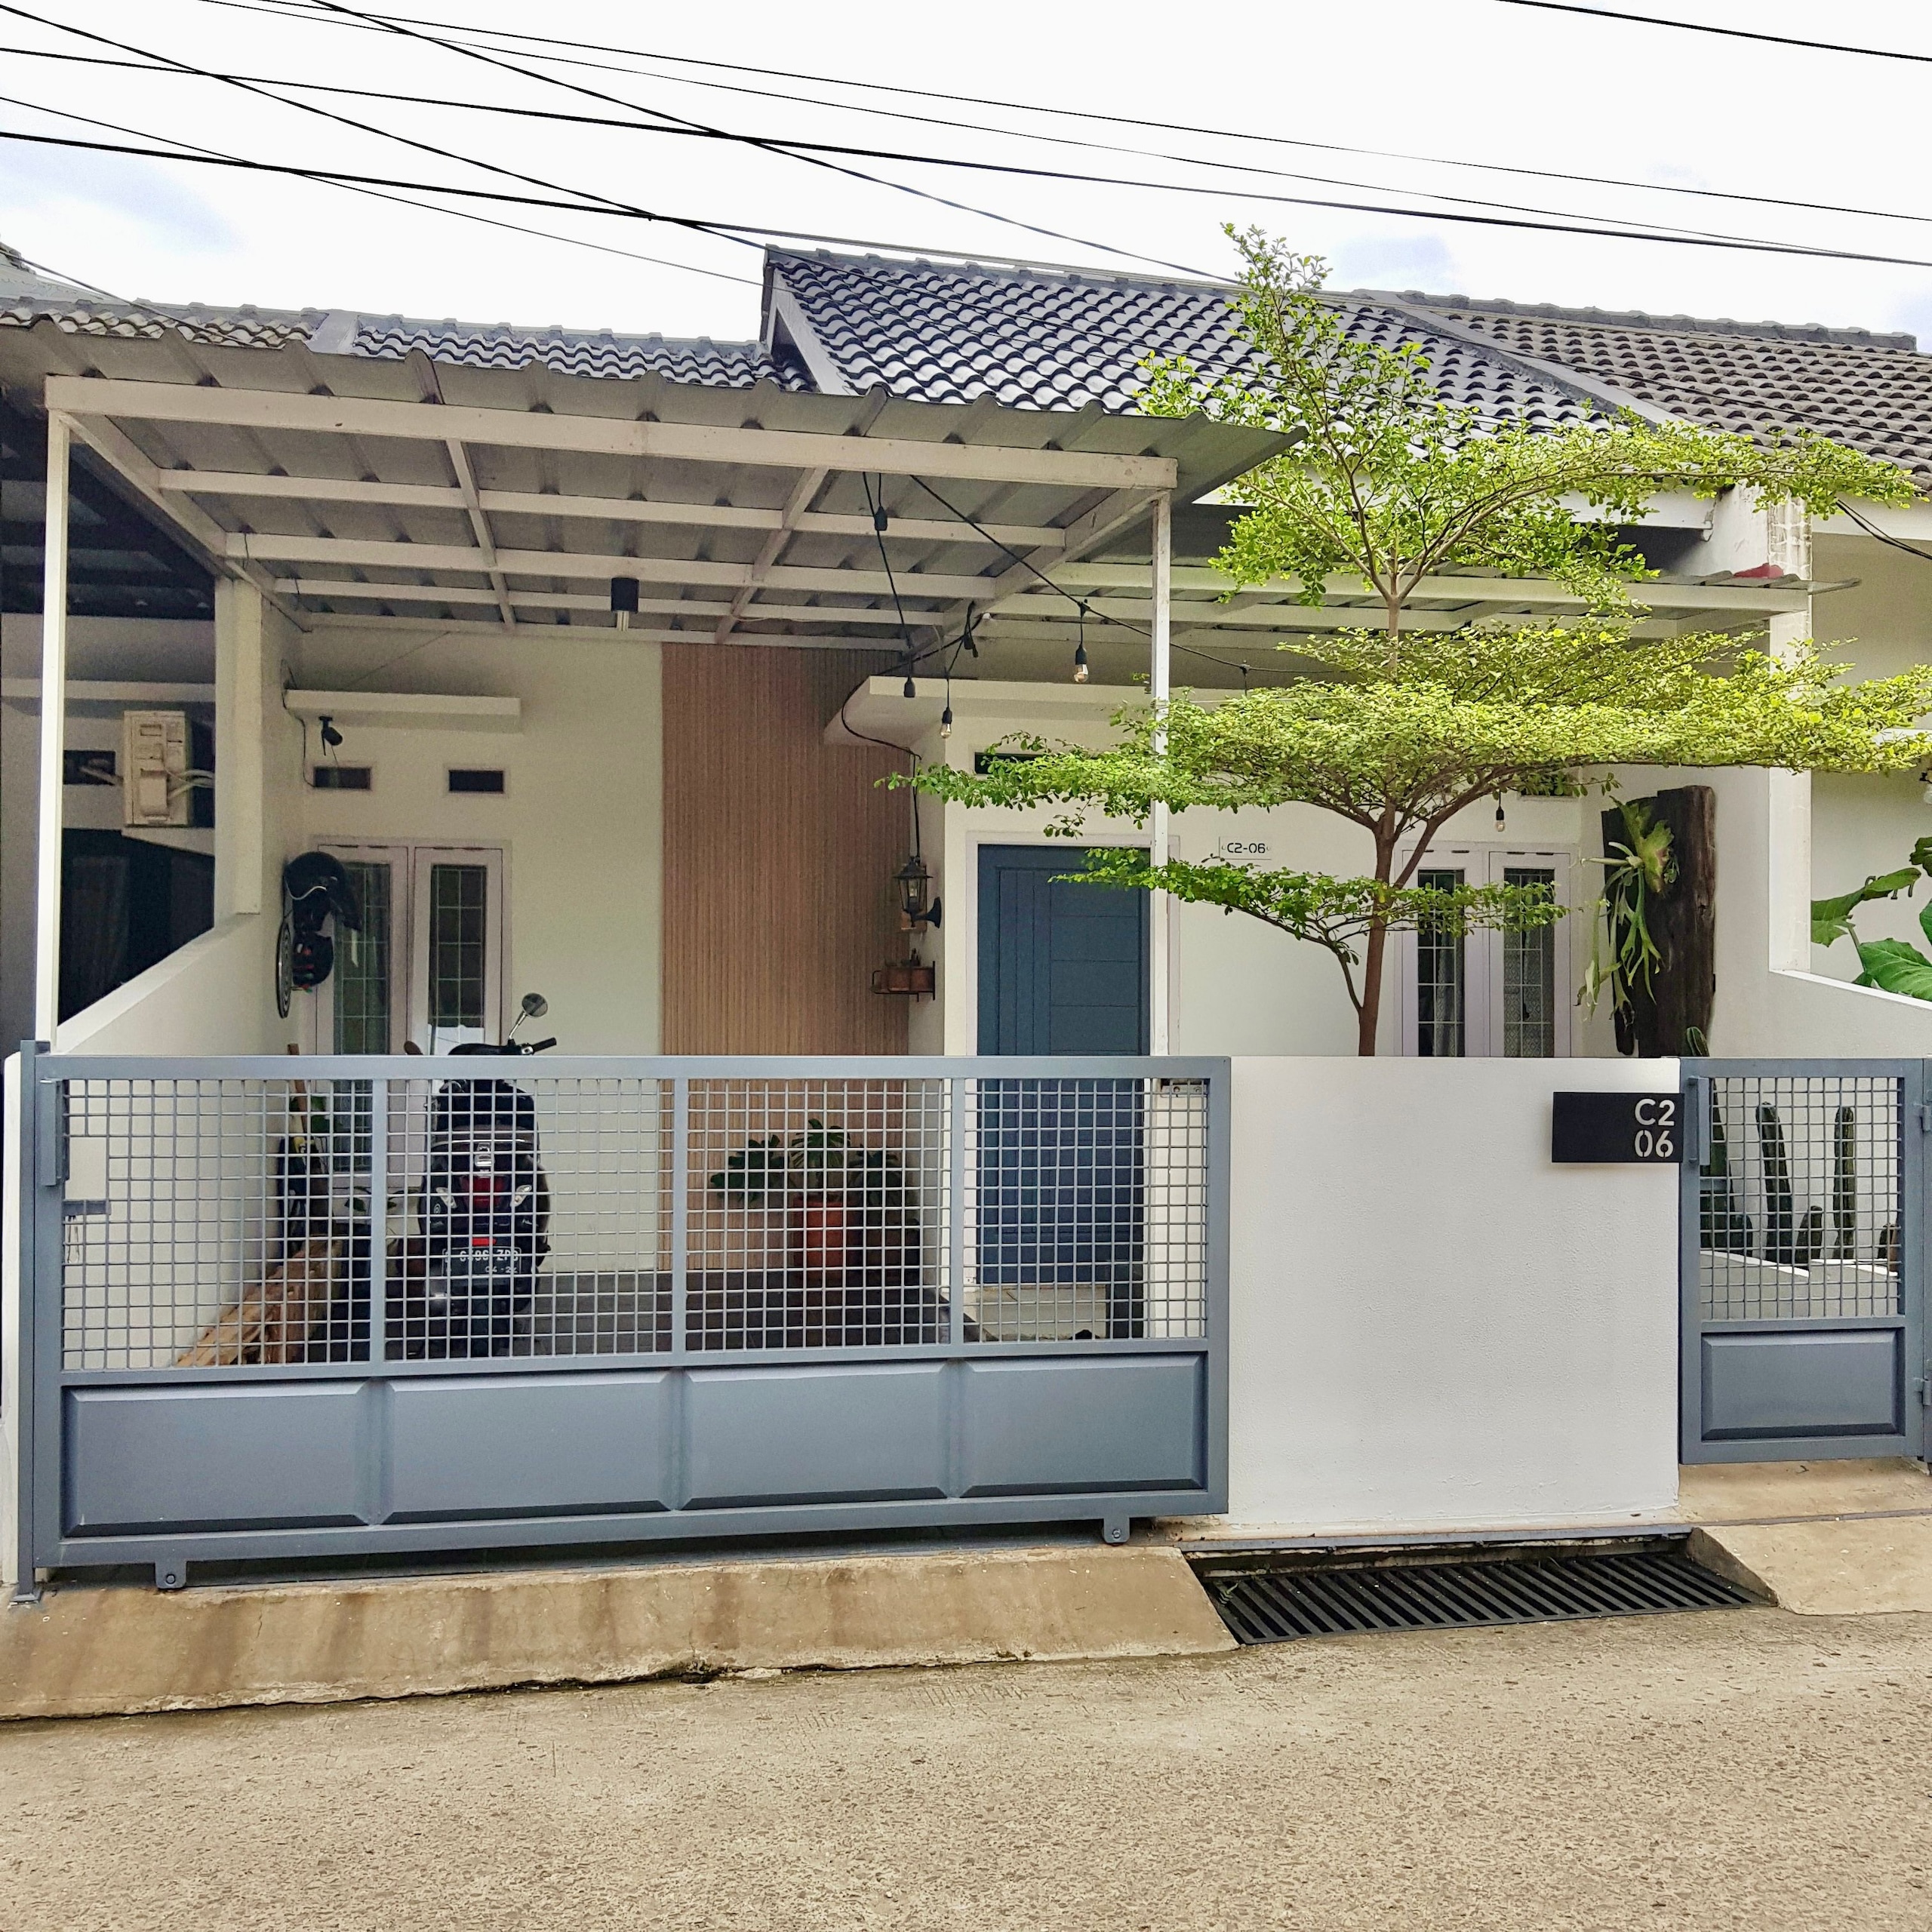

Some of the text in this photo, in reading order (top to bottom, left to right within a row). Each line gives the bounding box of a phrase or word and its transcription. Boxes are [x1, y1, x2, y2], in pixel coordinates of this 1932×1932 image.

[1227, 842, 1266, 854] C2-06
[1635, 1098, 1675, 1126] C2
[1635, 1129, 1674, 1158] 06
